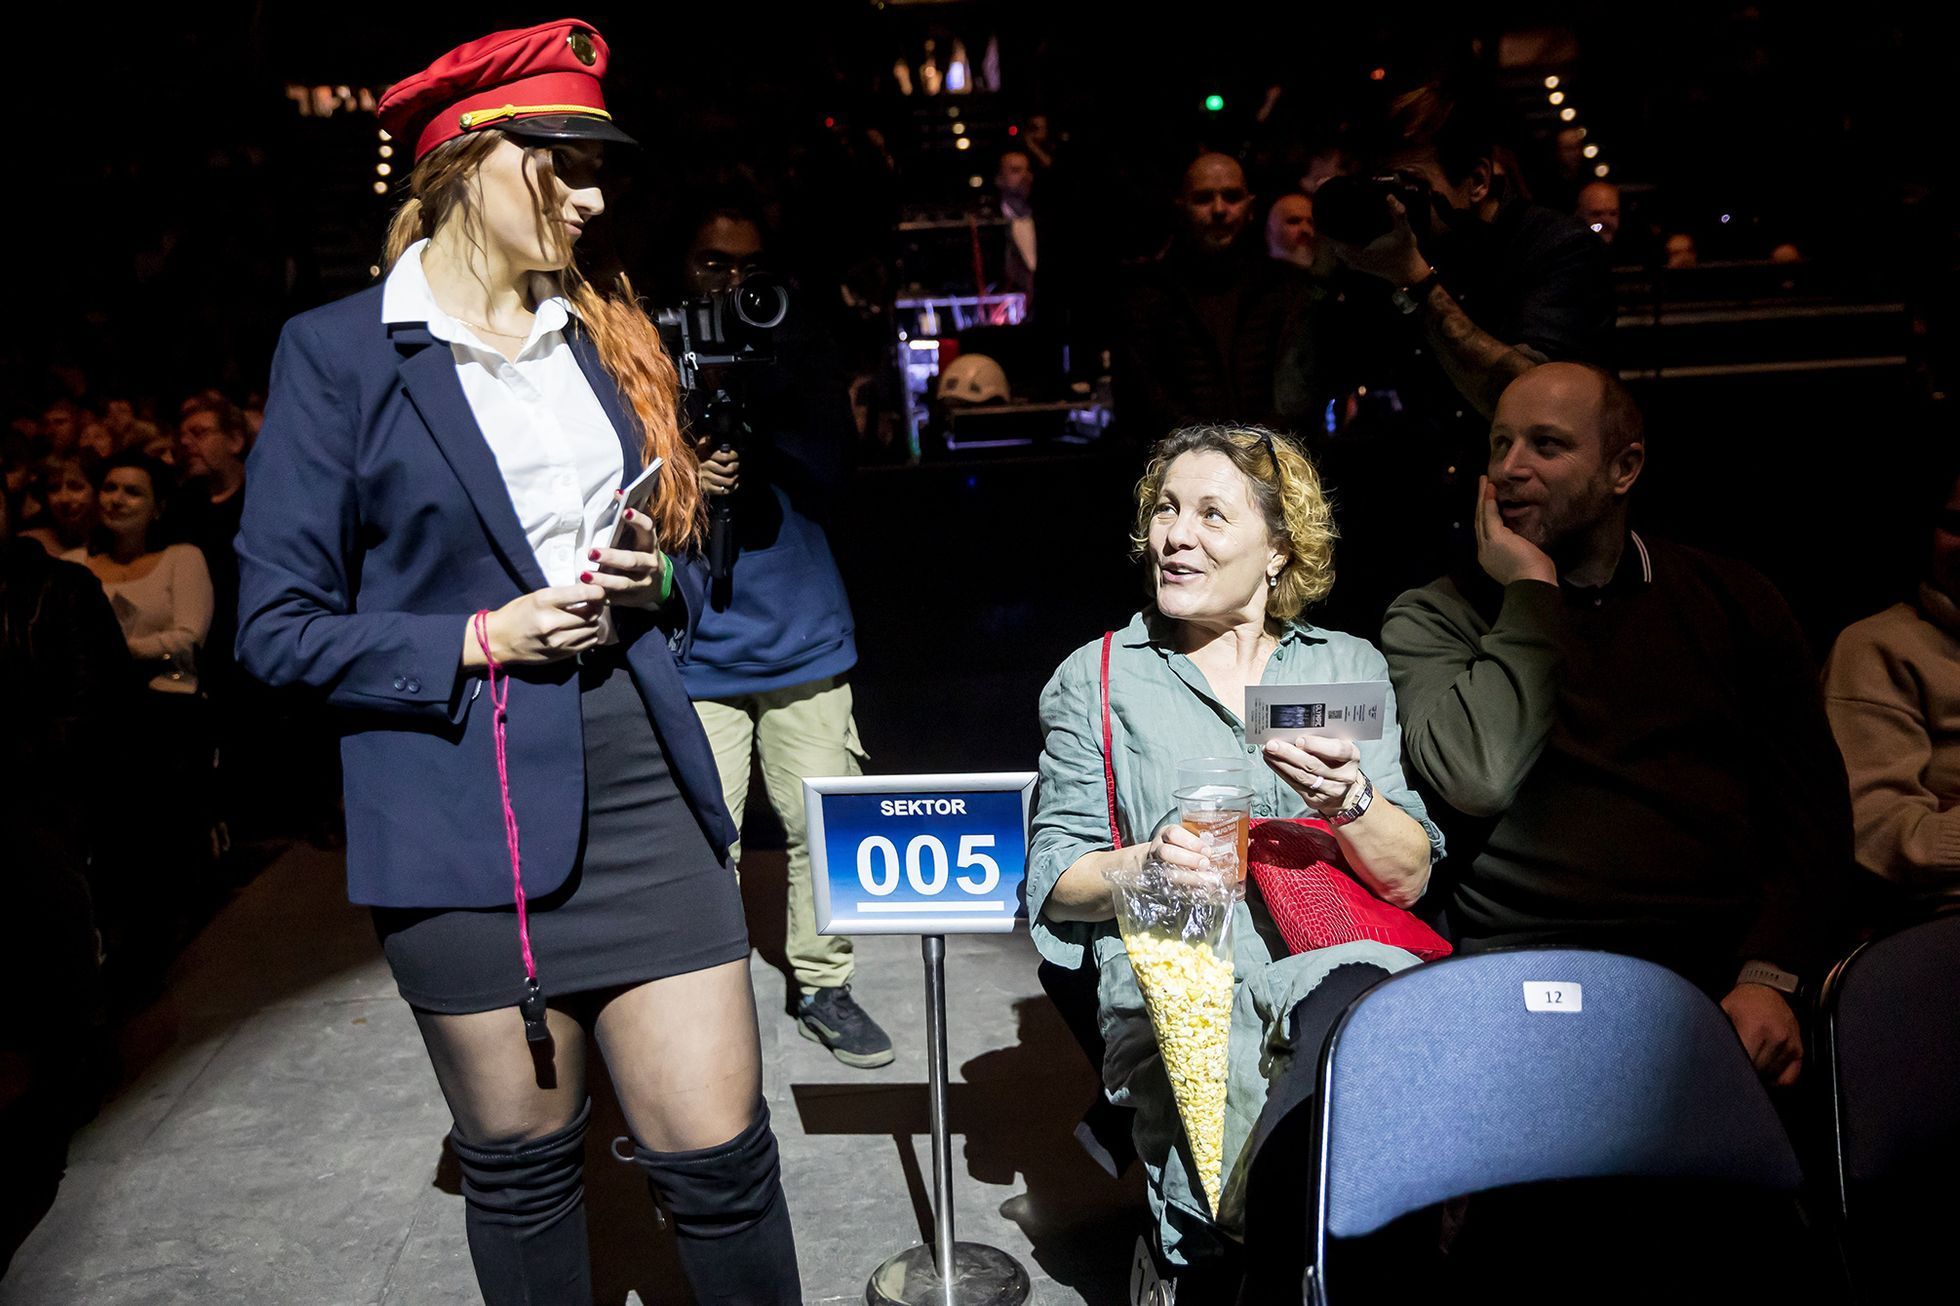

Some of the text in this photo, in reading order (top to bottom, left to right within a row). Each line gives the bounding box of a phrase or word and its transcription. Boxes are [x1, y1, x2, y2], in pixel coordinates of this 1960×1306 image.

[880, 799, 967, 816] SEKTOR
[856, 834, 1000, 896] 005
[1545, 991, 1562, 1003] 12
